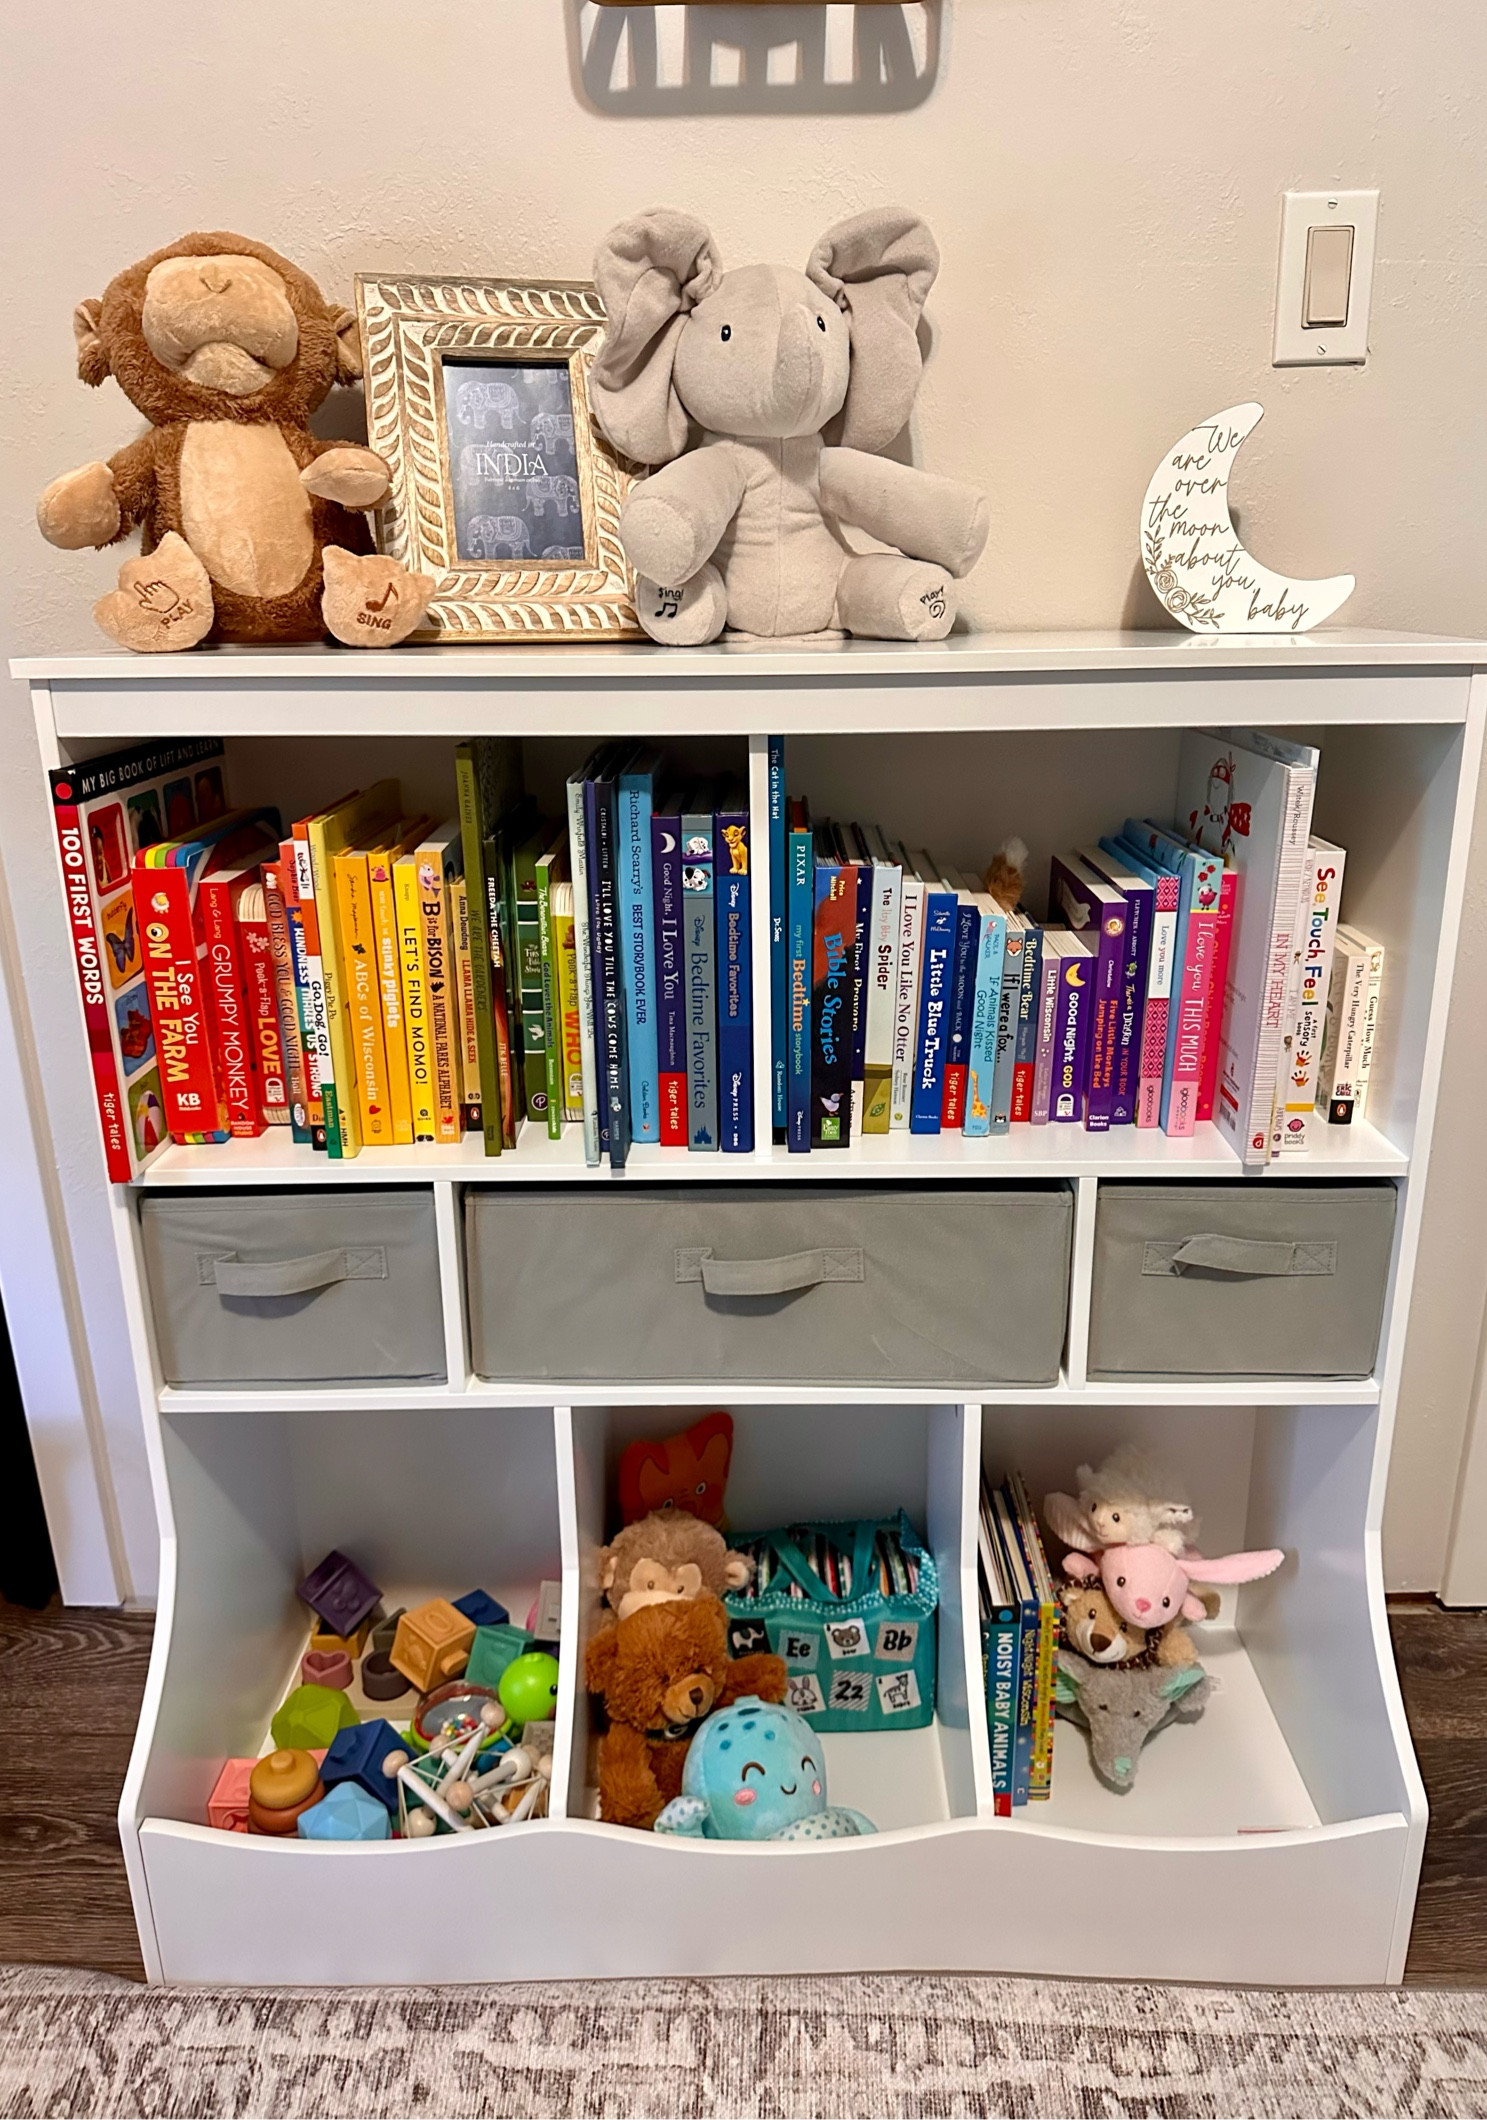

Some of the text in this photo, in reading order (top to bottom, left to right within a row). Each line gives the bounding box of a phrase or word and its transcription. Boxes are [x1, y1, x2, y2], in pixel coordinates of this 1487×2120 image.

[1192, 425, 1245, 453] We
[475, 454, 548, 476] INDIA
[1172, 454, 1211, 470] are
[1175, 477, 1227, 496] over
[1149, 493, 1188, 528] the
[1169, 520, 1229, 538] moon
[1174, 537, 1246, 575] about
[161, 598, 194, 629] PLAY
[657, 586, 684, 600] Sing!
[919, 585, 945, 605] Play!
[1248, 588, 1309, 629] baby
[356, 612, 392, 630] SING
[771, 749, 780, 764] The
[771, 766, 780, 779] Cat
[461, 771, 472, 824] JOANNA GAINES
[772, 791, 780, 804] the
[772, 806, 780, 819] Hat
[1289, 785, 1305, 846] Witek/Roussey
[574, 793, 586, 875] Emily Winfield Martin
[630, 790, 643, 895] Richard Scarry's
[796, 845, 806, 886] PIXAR
[728, 883, 739, 907] Disney
[61, 828, 103, 1005] 100 FIRST WORDS
[487, 877, 501, 968] FREEDA THE CHEETAH
[692, 915, 705, 946] Disney
[903, 905, 917, 937] Love
[1161, 925, 1170, 945] Love
[794, 925, 805, 957] my first
[901, 941, 915, 967] You
[381, 937, 401, 1027] stinky piglets
[581, 922, 595, 1039] The Wonderful Things You Will Be
[633, 904, 647, 1025] BEST STORYBOOK EVER
[728, 913, 740, 1017] Bedtime Favorites
[877, 945, 894, 990] Spider
[929, 949, 947, 996] Little
[1022, 938, 1037, 989] Bedtime
[1106, 960, 1115, 988] Christelow
[1157, 965, 1165, 985] more
[1266, 933, 1290, 1028] IN MY HEART
[146, 923, 188, 1082] ON THE FARM
[255, 963, 271, 1015] Peek-a-Flap
[543, 962, 554, 1048] God Loves the Animals
[602, 880, 619, 1089] I'LL LOVE YOU TILL THE COWS COME HOME
[792, 959, 807, 1032] Bedtime
[820, 932, 848, 1064] Bible Stories
[899, 971, 913, 1000] Like
[404, 928, 428, 1085] LET'S FIND MOMO!
[898, 1004, 911, 1022] No
[927, 1001, 943, 1036] Blue
[974, 990, 987, 1049] Good Night
[984, 977, 1000, 1062] If Animals Kissed
[1020, 991, 1034, 1021] Bear
[1043, 969, 1057, 1043] Little Wisconsin
[1344, 963, 1365, 1069] The Very Hungry Caterpillar
[1367, 996, 1378, 1021] Guess
[212, 945, 249, 1109] GRUMPY MONKEY
[258, 1018, 281, 1074] LOVE
[354, 960, 378, 1100] ABCs of Wisconsin
[564, 1009, 581, 1065] WHO
[691, 953, 710, 1109] Bedtime Favorites
[896, 1026, 910, 1062] Otter
[1093, 999, 1107, 1089] Jumping on the Bed
[1103, 1000, 1118, 1088] Five Little Monkeys
[1366, 1023, 1375, 1044] How
[794, 1033, 803, 1075] storybook
[922, 1038, 941, 1089] Truck
[1362, 1046, 1372, 1069] Much
[177, 1093, 201, 1106] KB
[641, 1081, 649, 1101] Golden
[947, 1072, 959, 1120] tiger tales
[1016, 1070, 1027, 1093] tiger
[102, 1093, 121, 1150] tiger tales
[325, 1090, 335, 1128] Eastman
[668, 1080, 679, 1130] tiger tales
[1014, 1094, 1024, 1117] tales
[1146, 1085, 1155, 1123] igloobooks
[1179, 1088, 1190, 1130] igloobooks
[787, 1637, 811, 1658] Ee
[883, 1629, 912, 1651] Bb
[996, 1632, 1014, 1678] NOISY
[995, 1682, 1012, 1718] BABY
[992, 1722, 1010, 1788] ANIMALS
